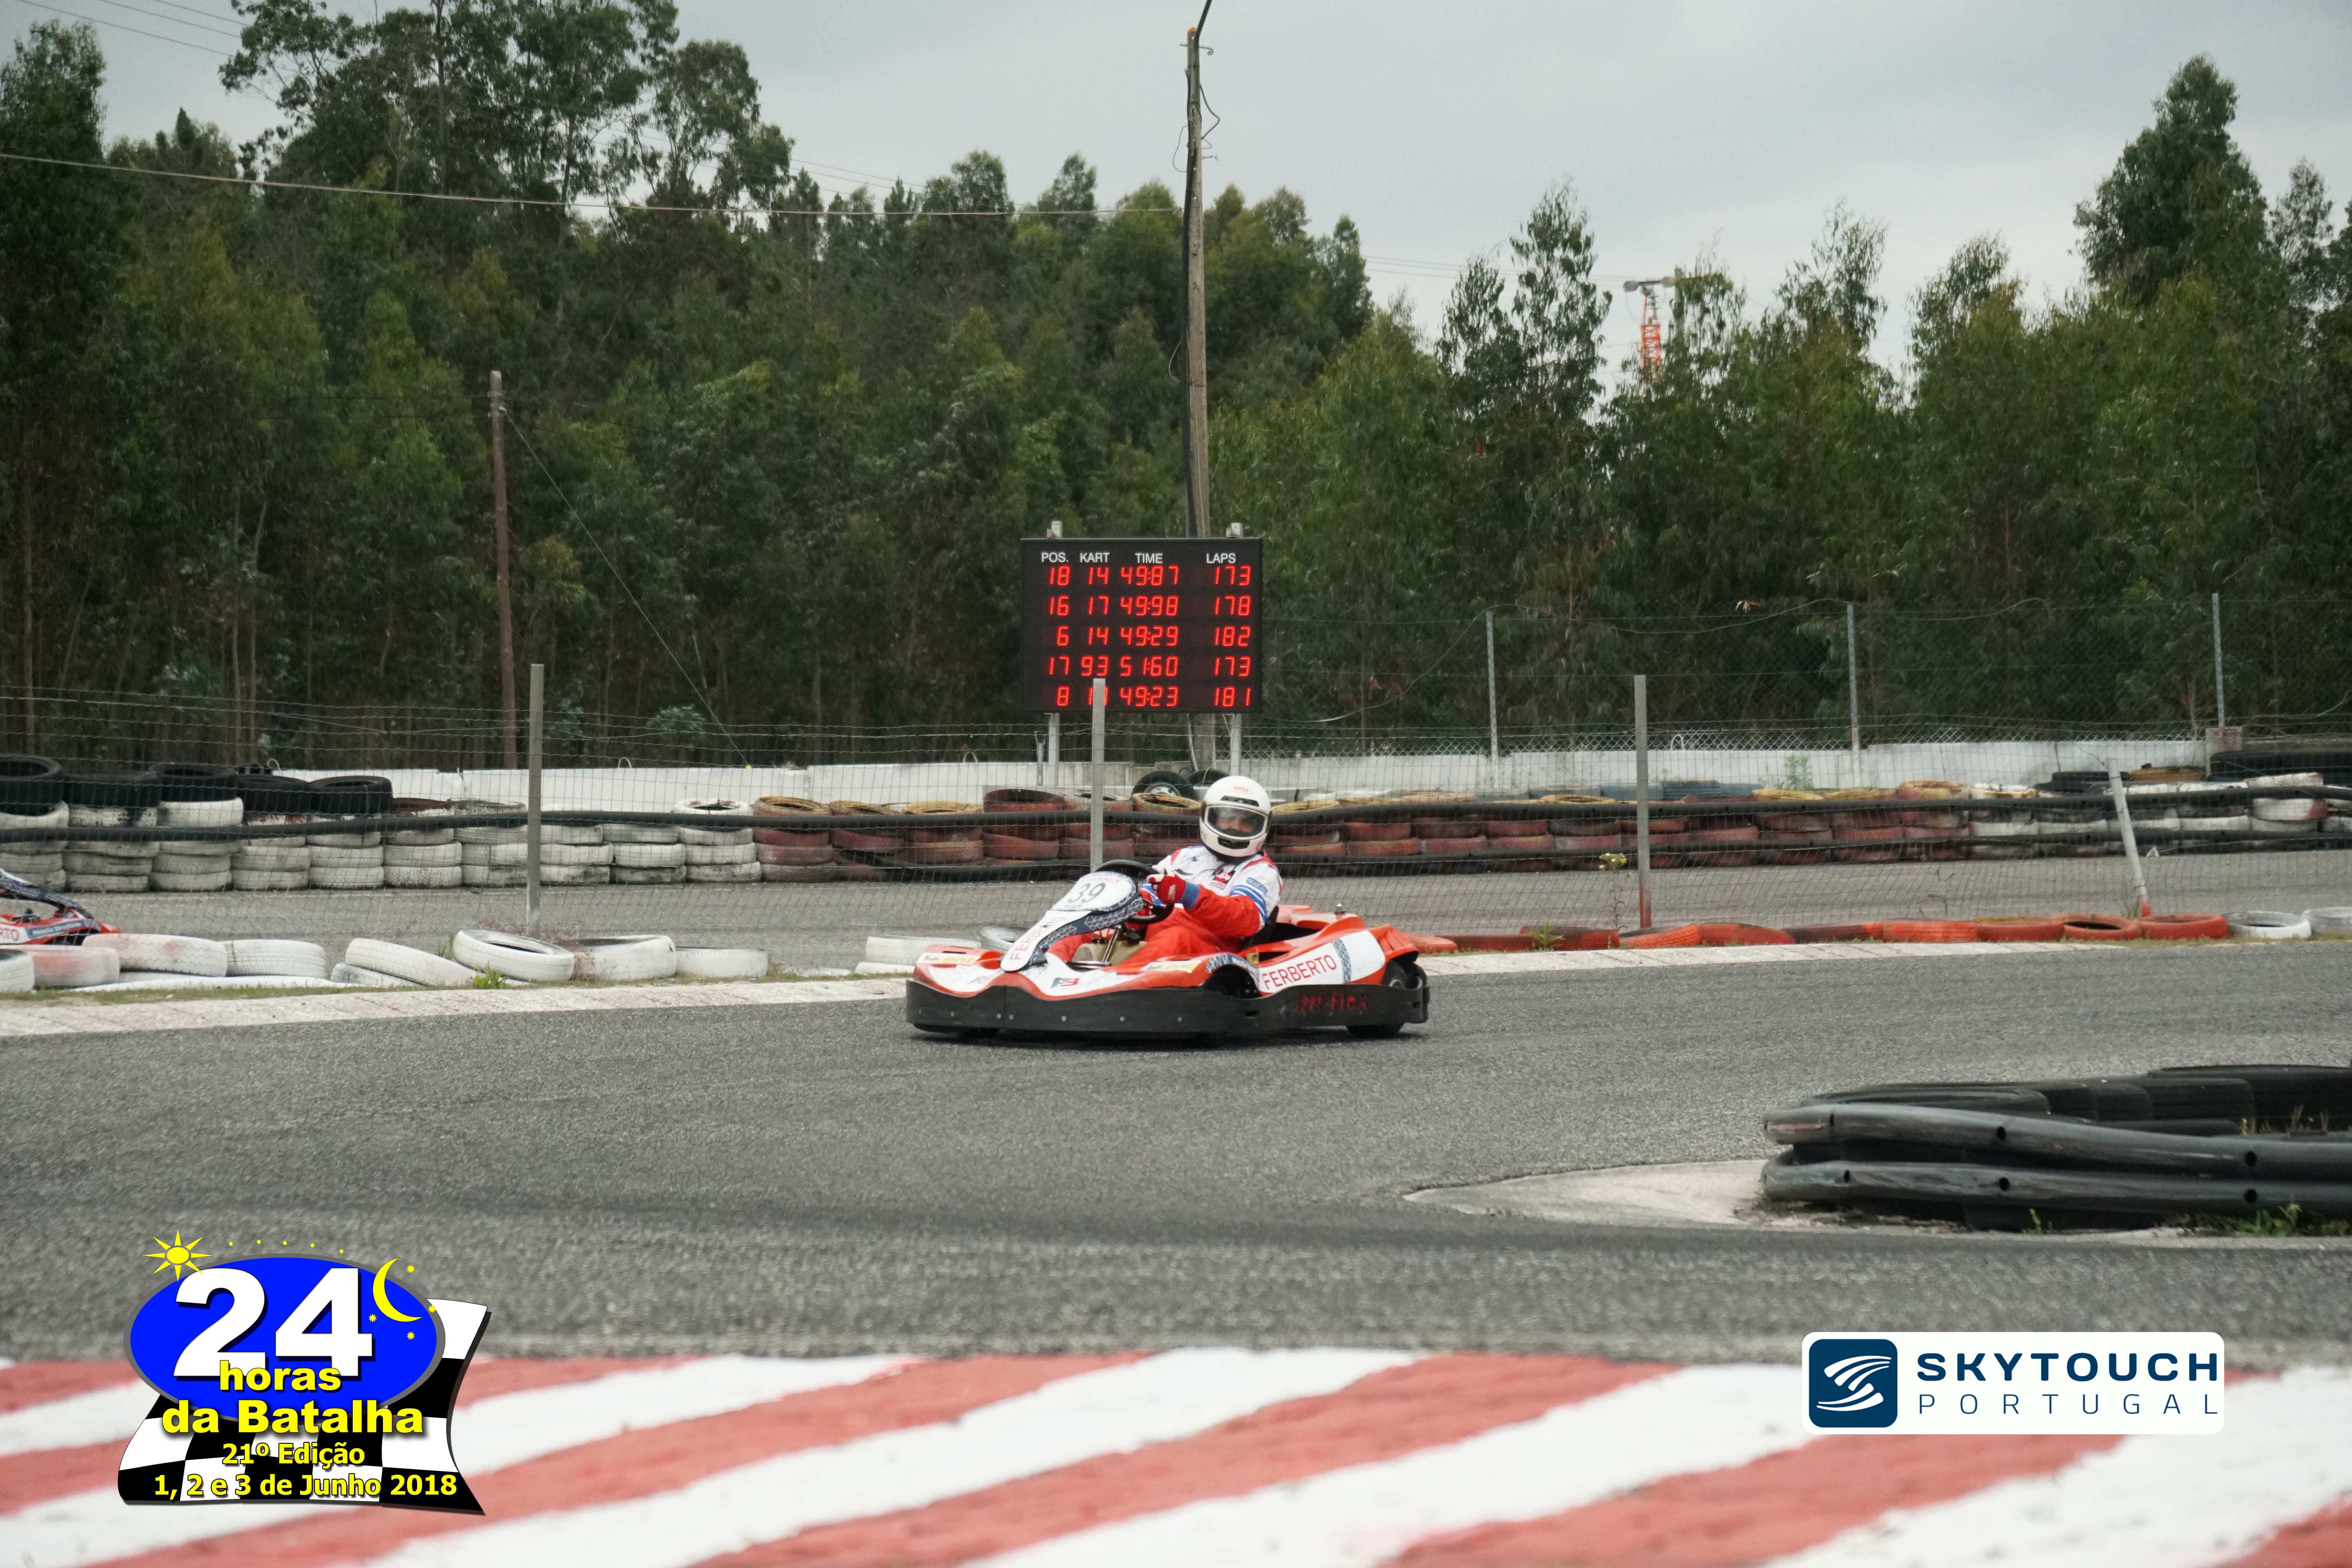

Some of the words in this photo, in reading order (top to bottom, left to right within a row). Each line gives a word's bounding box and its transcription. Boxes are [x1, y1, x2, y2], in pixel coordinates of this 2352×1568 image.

[1042, 552, 1069, 563] POS.
[1080, 553, 1110, 563] KART
[1135, 553, 1163, 564] TIME
[1206, 553, 1236, 564] LAPS
[1049, 565, 1071, 586] 18
[1088, 566, 1109, 585] 14
[1120, 565, 1179, 586] 49:87
[1214, 565, 1251, 586] 173
[1049, 595, 1070, 617] 16
[1088, 595, 1109, 615] 17
[1120, 595, 1179, 617] 49:98
[1214, 595, 1251, 617] 178
[1056, 626, 1070, 646] 6
[1088, 627, 1109, 645] 14
[1120, 625, 1179, 647] 49:29
[1214, 625, 1251, 647] 182
[1049, 655, 1070, 675] 17
[1080, 655, 1109, 677] 93
[1214, 655, 1251, 677] 173
[1056, 686, 1070, 707] 8
[1087, 686, 1109, 706] 1
[1119, 686, 1179, 707] 49:23
[1213, 686, 1251, 707] 181
[1067, 882, 1106, 903] 39
[1262, 955, 1337, 990] FERBERTO
